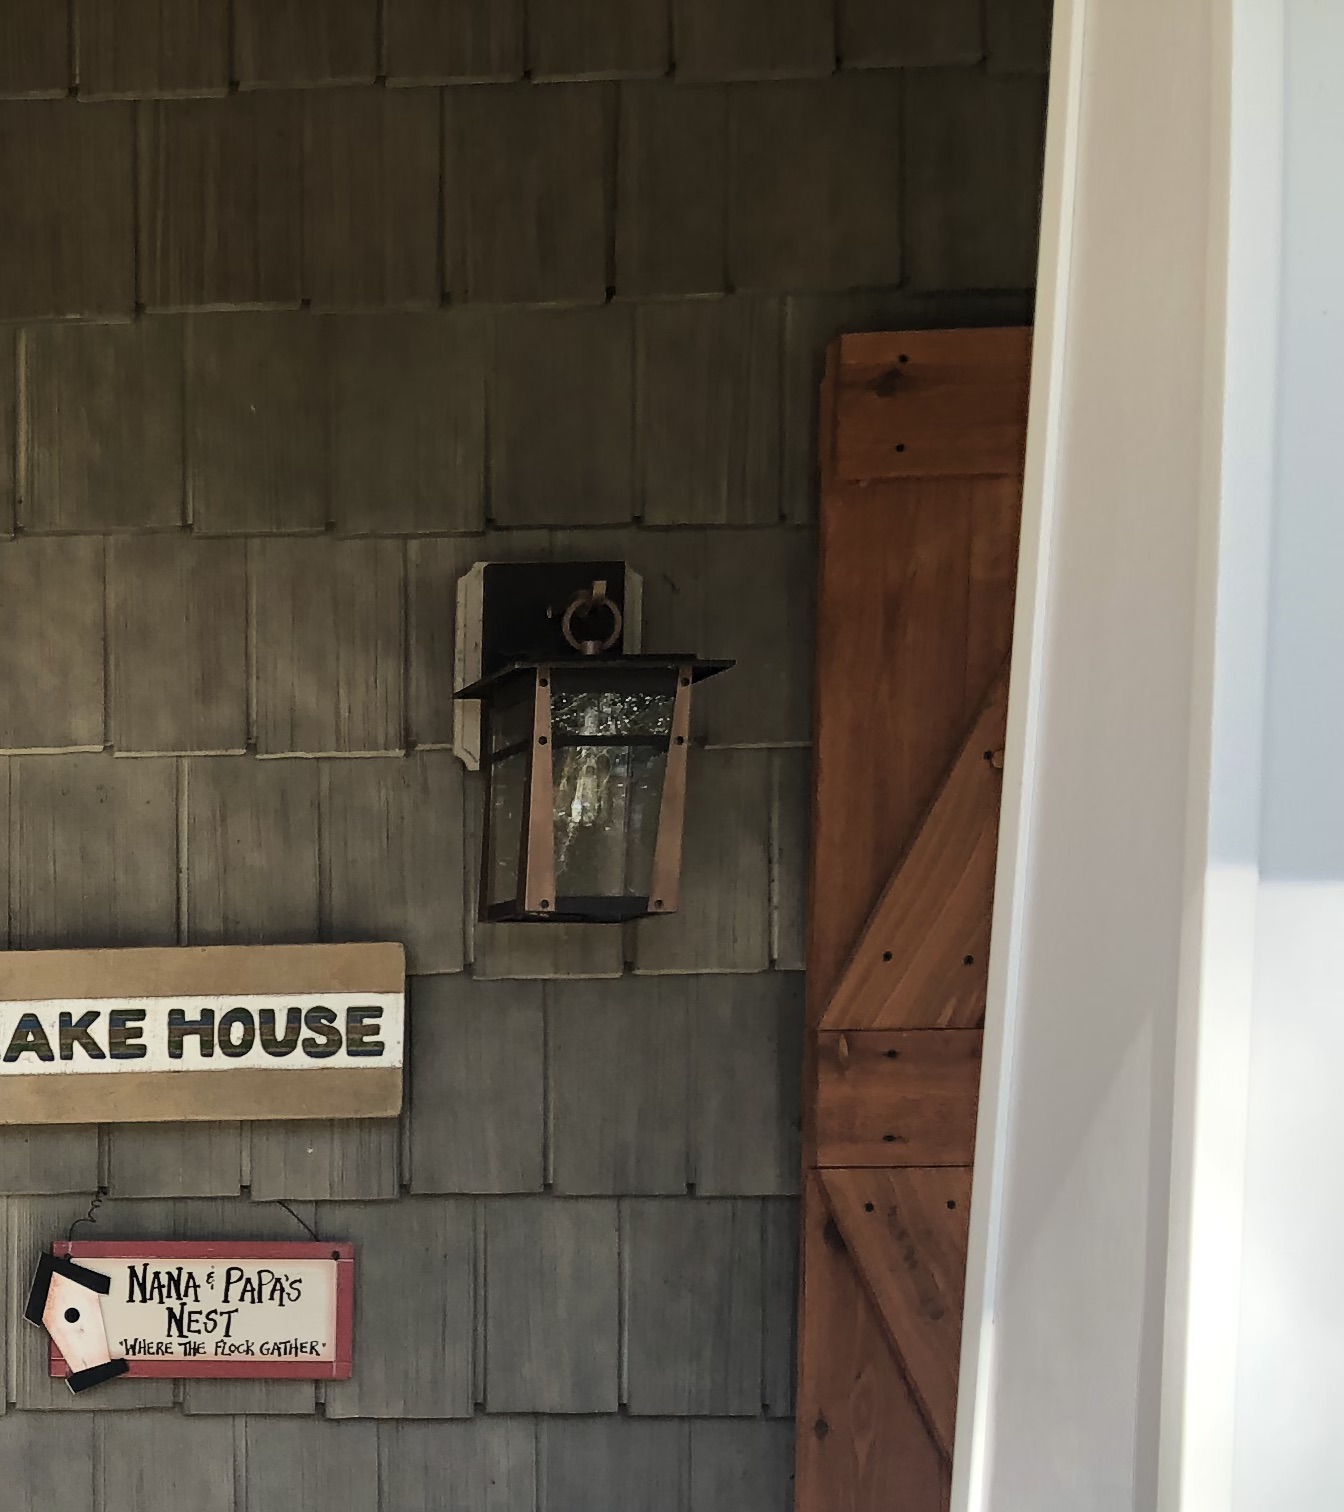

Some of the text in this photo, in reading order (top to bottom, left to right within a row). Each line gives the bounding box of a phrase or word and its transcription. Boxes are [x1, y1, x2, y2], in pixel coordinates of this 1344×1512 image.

[166, 1005, 386, 1059] HOUSE
[126, 1263, 201, 1304] NANA
[222, 1267, 303, 1307] PAPA'S
[166, 1302, 239, 1338] NEST
[178, 1341, 207, 1357] THE
[214, 1338, 255, 1357] FLOCK
